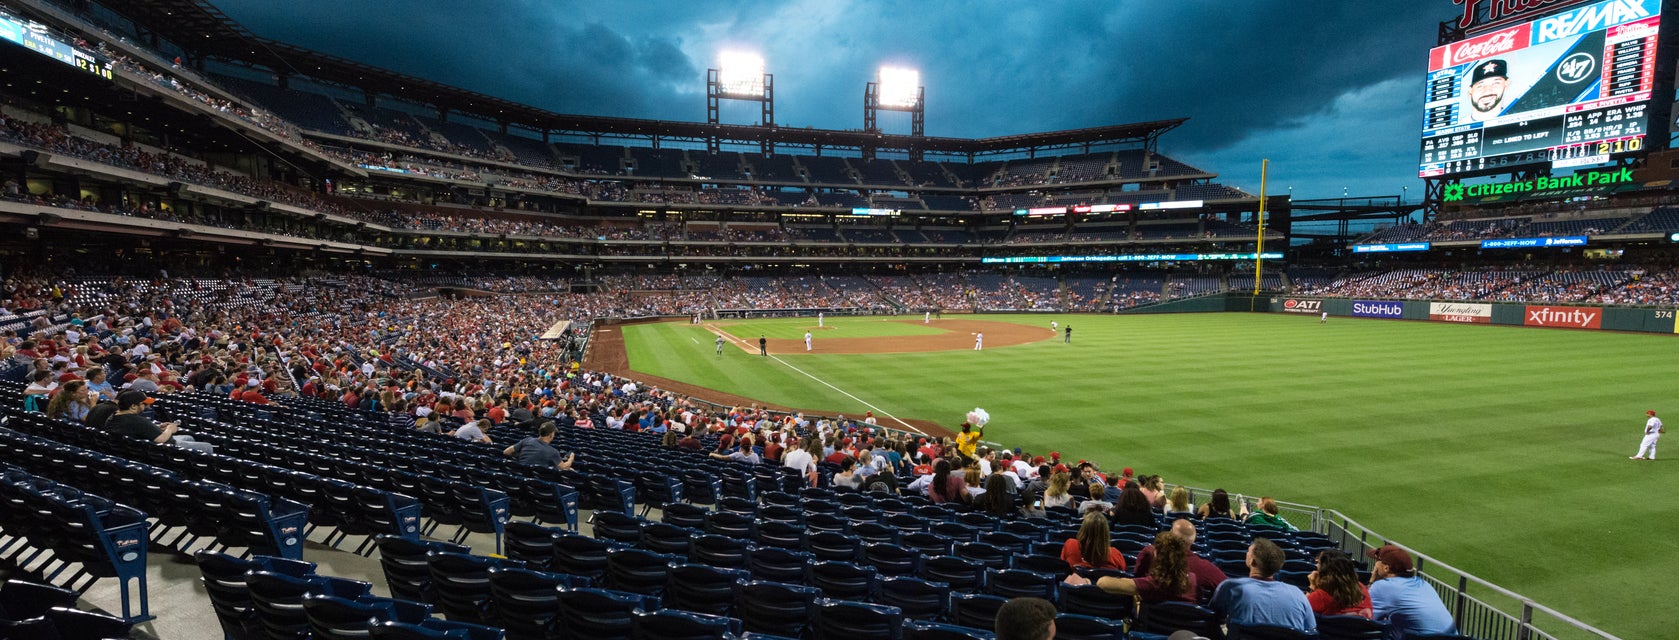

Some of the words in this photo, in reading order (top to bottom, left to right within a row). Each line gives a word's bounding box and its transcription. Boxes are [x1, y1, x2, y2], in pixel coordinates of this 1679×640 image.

[1587, 112, 1602, 120] APP
[1624, 104, 1646, 113] WHIP
[1504, 136, 1522, 144] LINED
[1599, 143, 1610, 155] 2
[1614, 141, 1624, 152] 1
[1628, 138, 1640, 151] 0
[1468, 180, 1533, 198] Citizens
[1536, 171, 1584, 190] Bank
[1587, 167, 1634, 186] Park
[1296, 300, 1320, 310] ATI
[1353, 303, 1402, 316] StubHub
[1437, 304, 1482, 314] Yuengling
[1529, 308, 1596, 327] xfinity
[1655, 310, 1672, 319] 374
